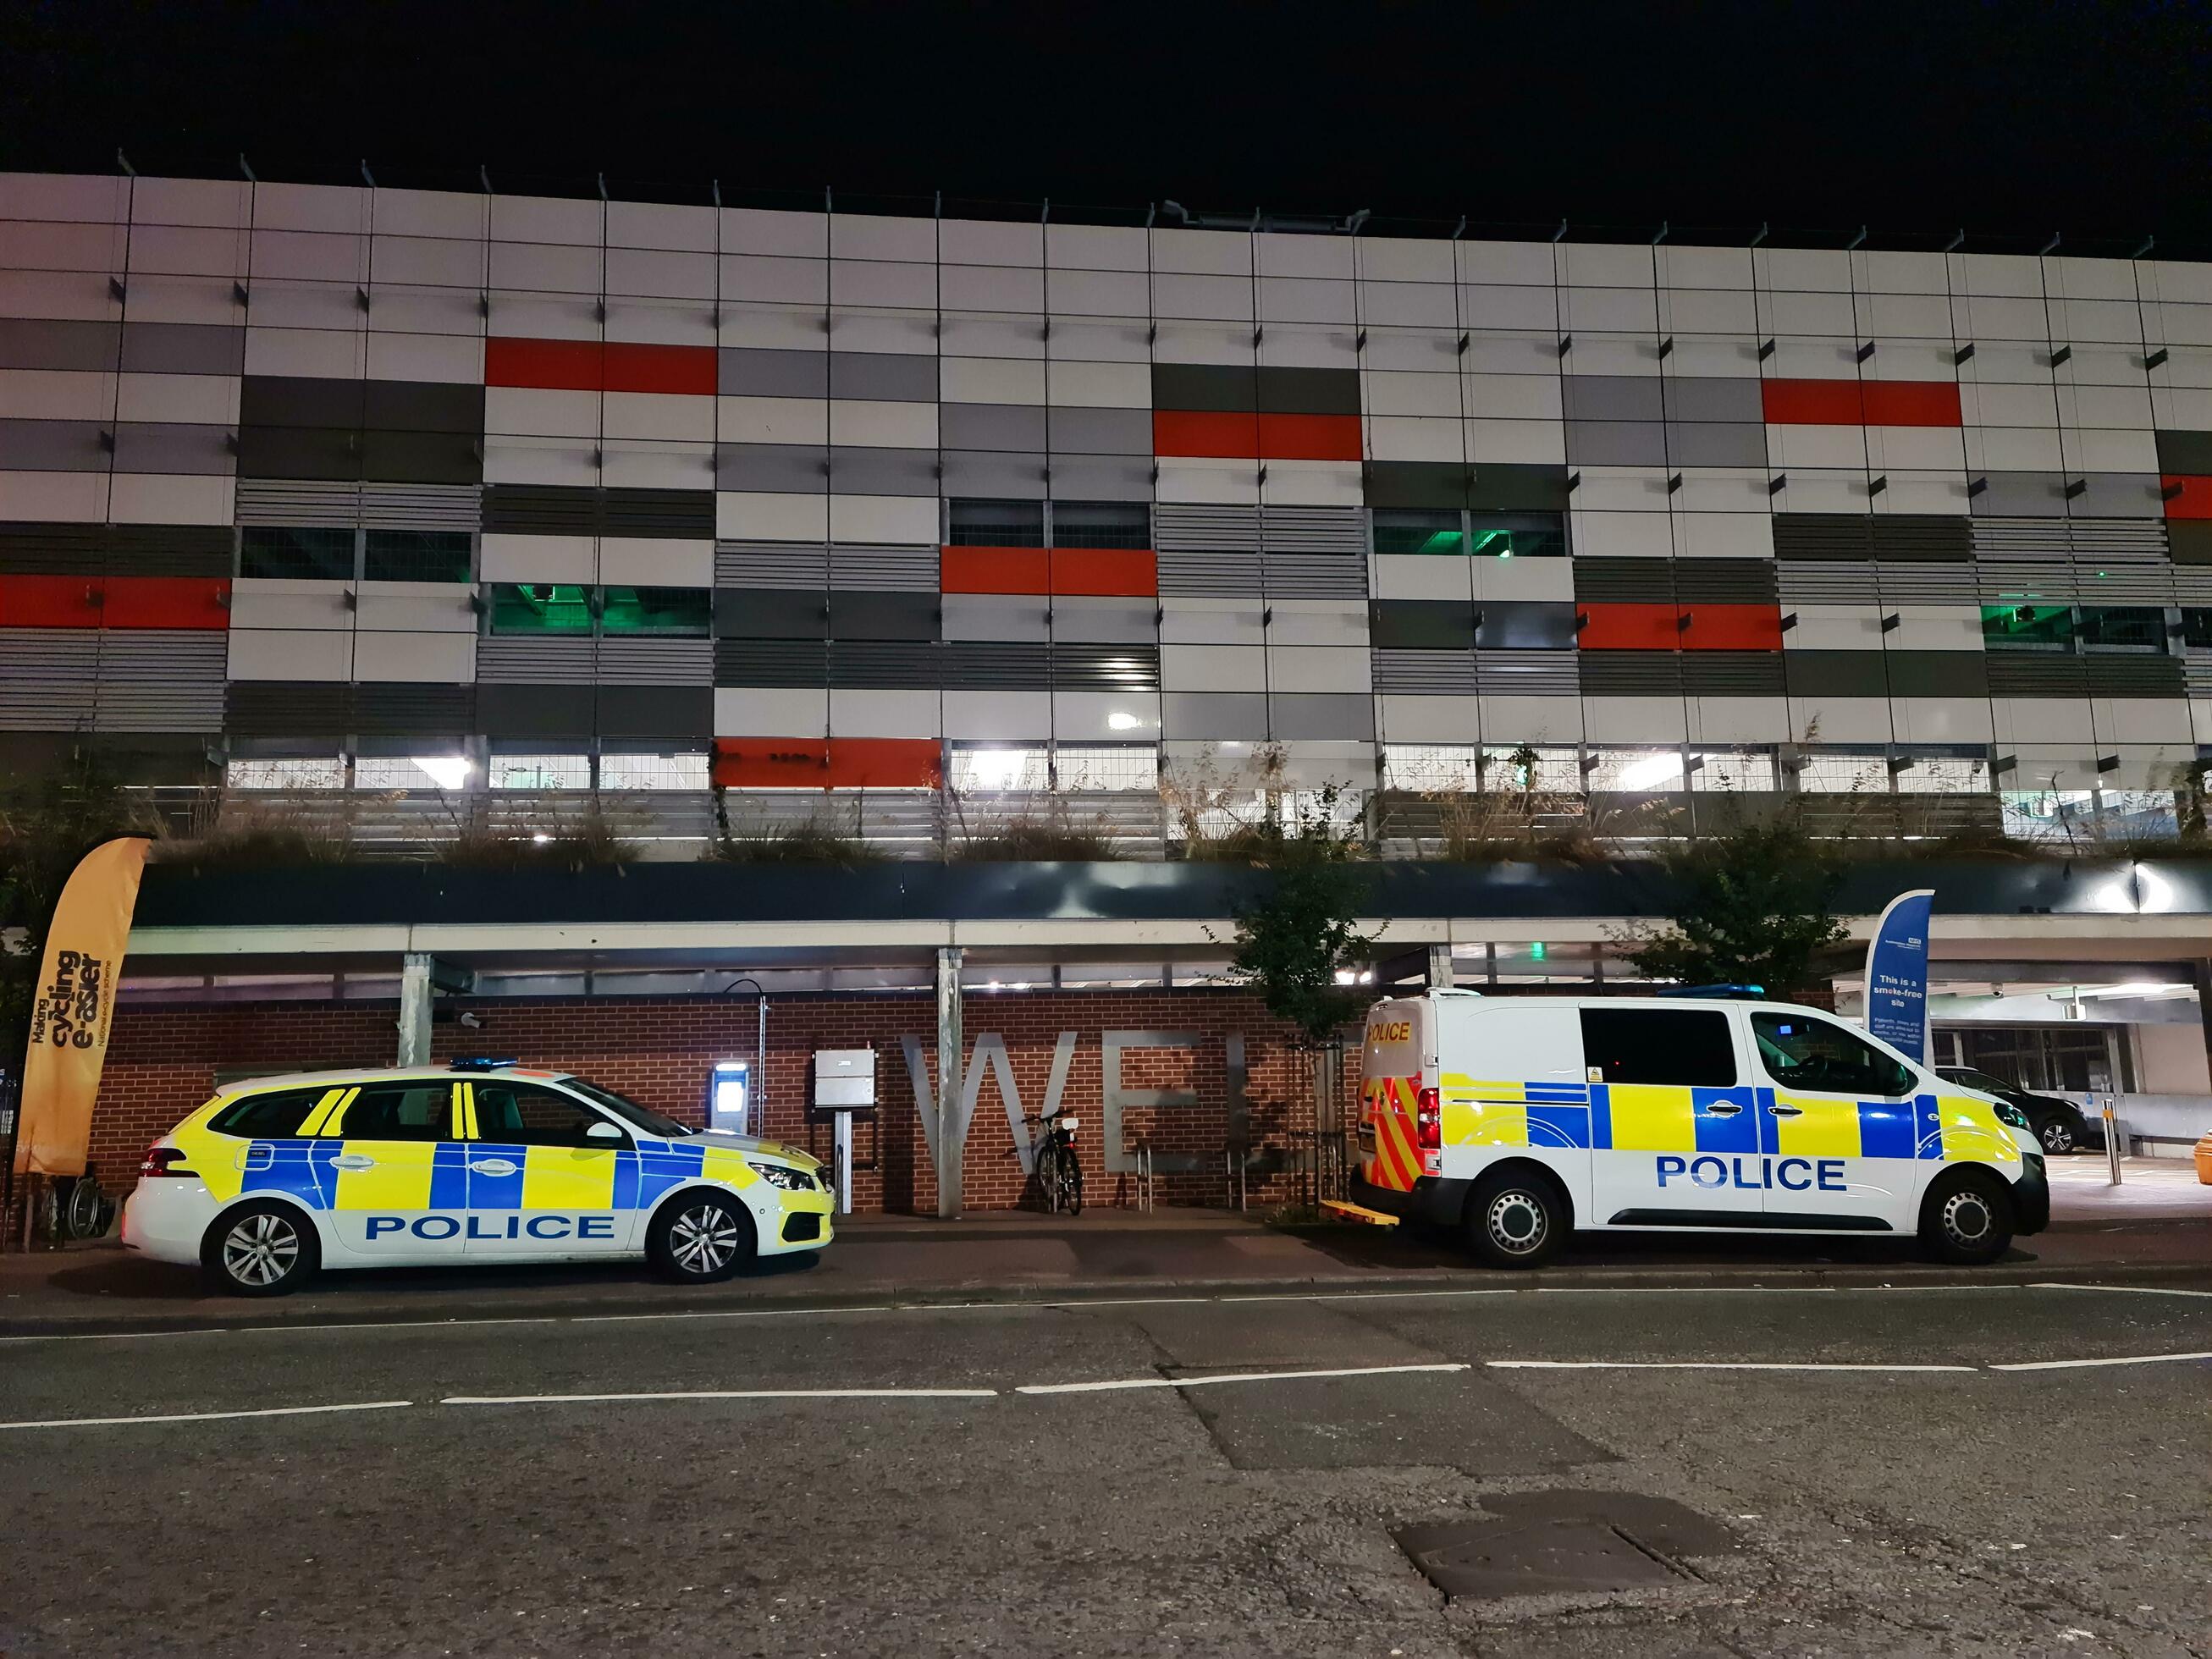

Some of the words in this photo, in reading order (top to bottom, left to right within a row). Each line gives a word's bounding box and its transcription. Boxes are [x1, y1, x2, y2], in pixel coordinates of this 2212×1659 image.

[1873, 987, 1922, 999] smoke-free
[1879, 974, 1898, 984] This
[1900, 977, 1909, 986] is
[47, 951, 81, 1047] cycling
[72, 953, 102, 1049] e-asier
[97, 1017, 107, 1046] National
[103, 960, 112, 989] scheme
[1891, 999, 1905, 1007] site
[32, 999, 49, 1044] Making
[1656, 1155, 1847, 1192] POLICE
[365, 1215, 615, 1240] POLICE
